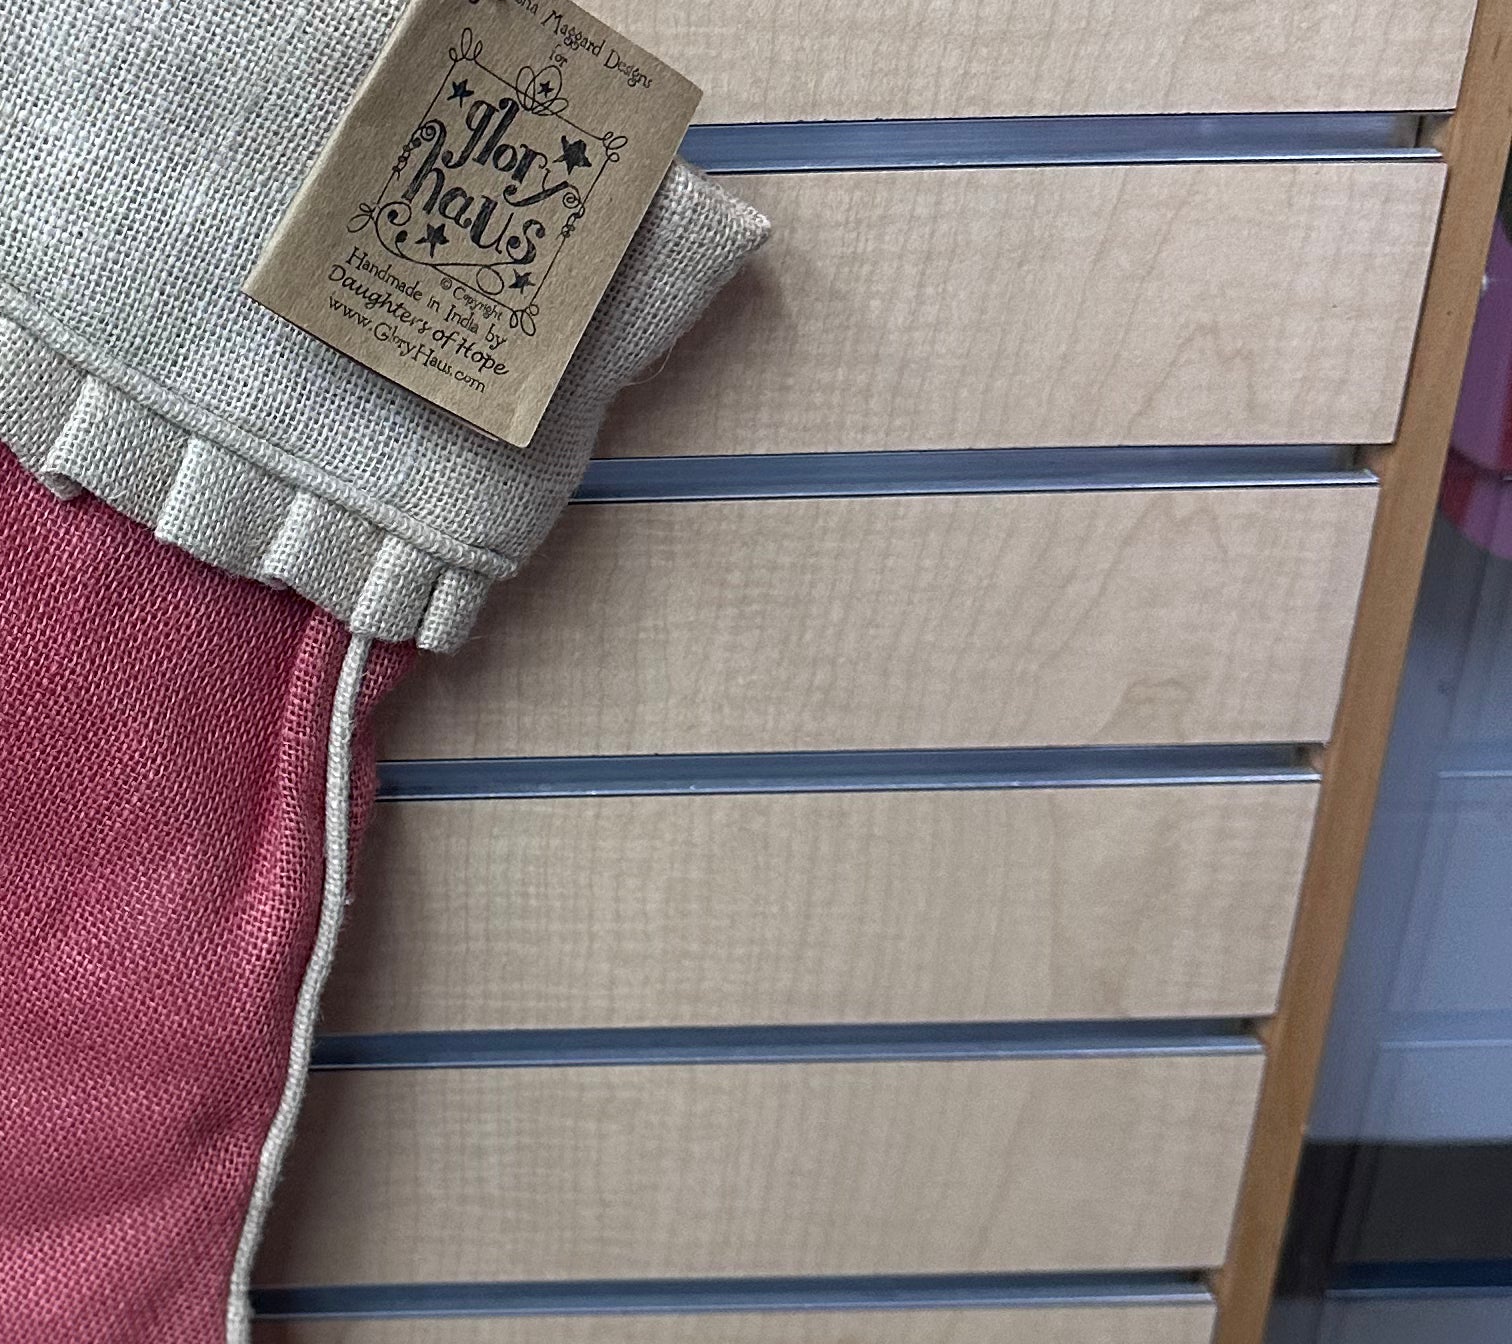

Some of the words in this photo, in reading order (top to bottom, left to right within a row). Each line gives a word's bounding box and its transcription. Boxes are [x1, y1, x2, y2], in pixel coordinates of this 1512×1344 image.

[540, 9, 607, 58] Maggard
[603, 48, 654, 89] Designs
[549, 43, 568, 69] for
[328, 263, 433, 334] Daughters
[431, 329, 460, 350] of
[454, 336, 511, 376] Hope
[344, 246, 424, 301] Handmade
[426, 295, 442, 313] in
[443, 303, 480, 335] India
[484, 322, 508, 351] by
[452, 285, 504, 322] Copyright
[328, 294, 487, 394] www.GloryHaus.com
